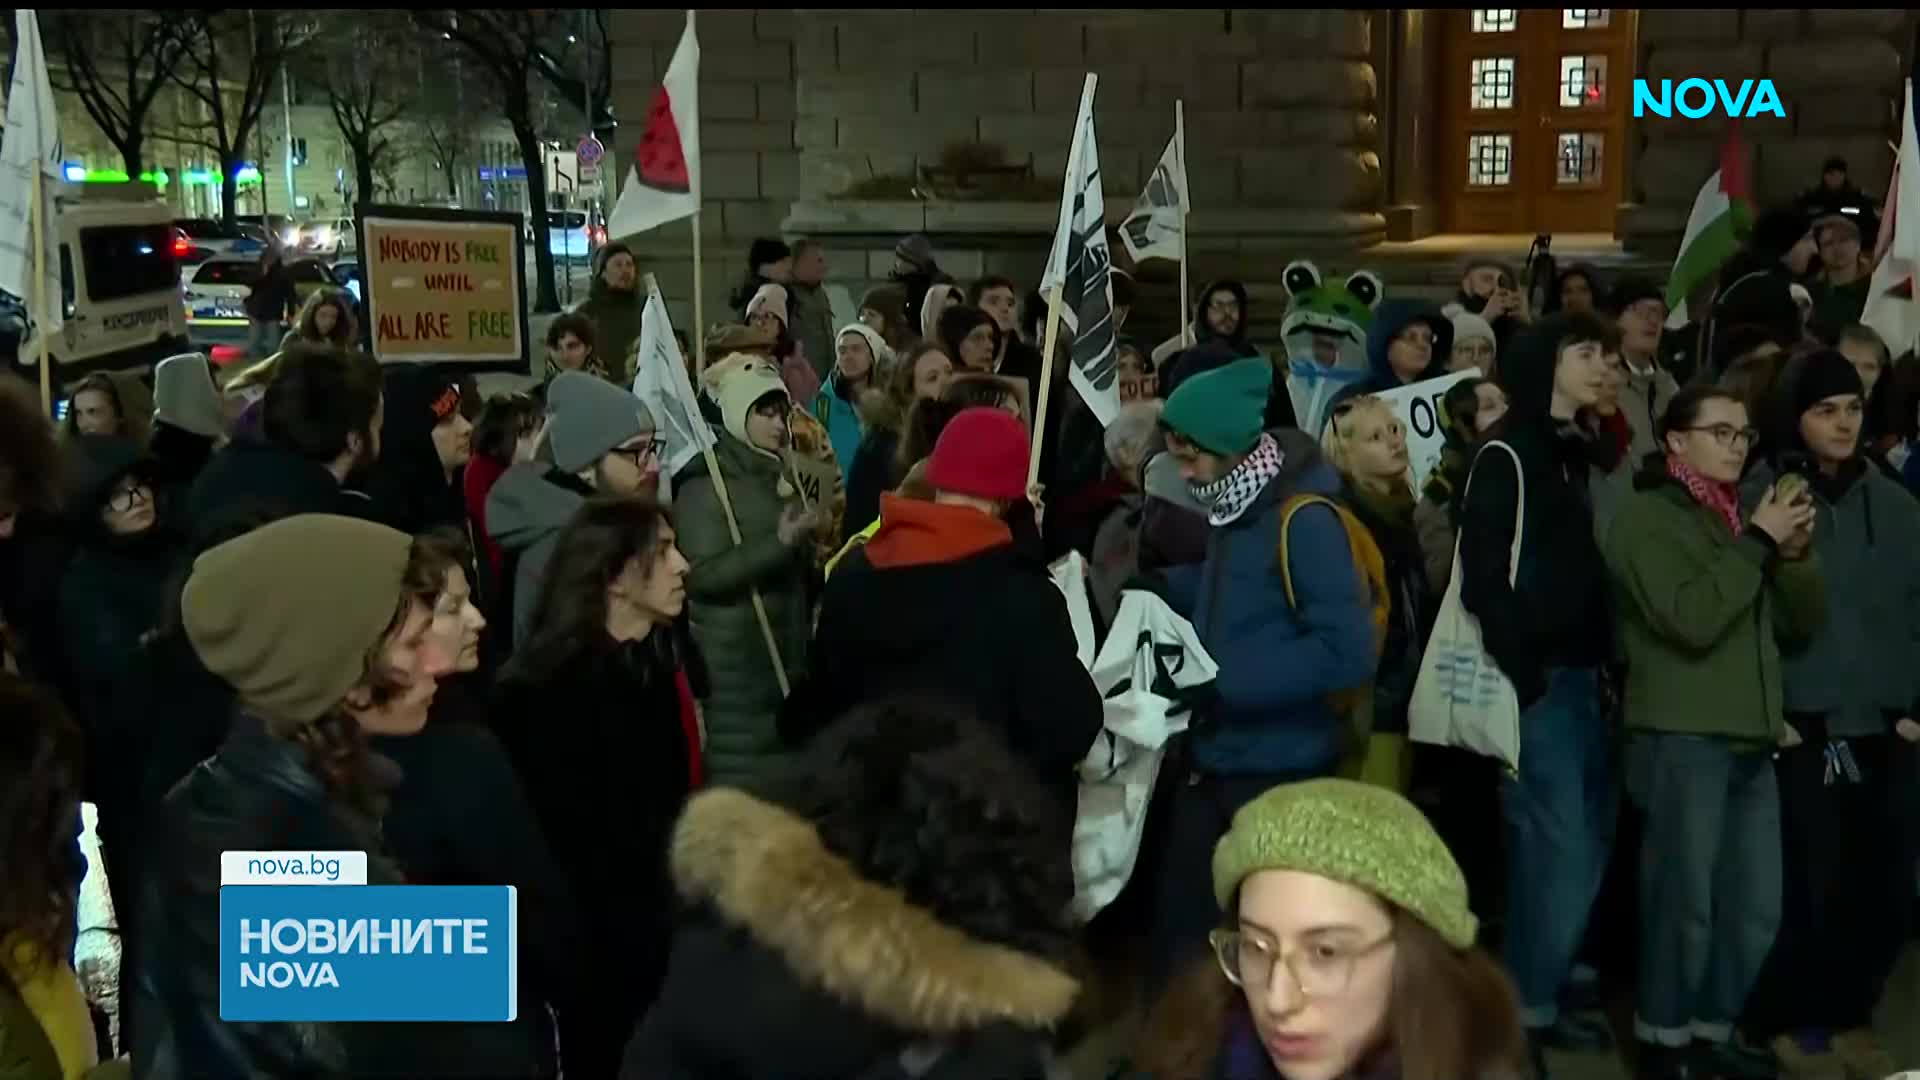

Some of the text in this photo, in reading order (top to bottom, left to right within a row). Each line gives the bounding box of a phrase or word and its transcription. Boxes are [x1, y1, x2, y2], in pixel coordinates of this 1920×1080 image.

[378, 234, 500, 265] NOBODY IS FREE
[424, 272, 474, 292] UNTIL
[377, 308, 513, 343] ALL ARE FREE
